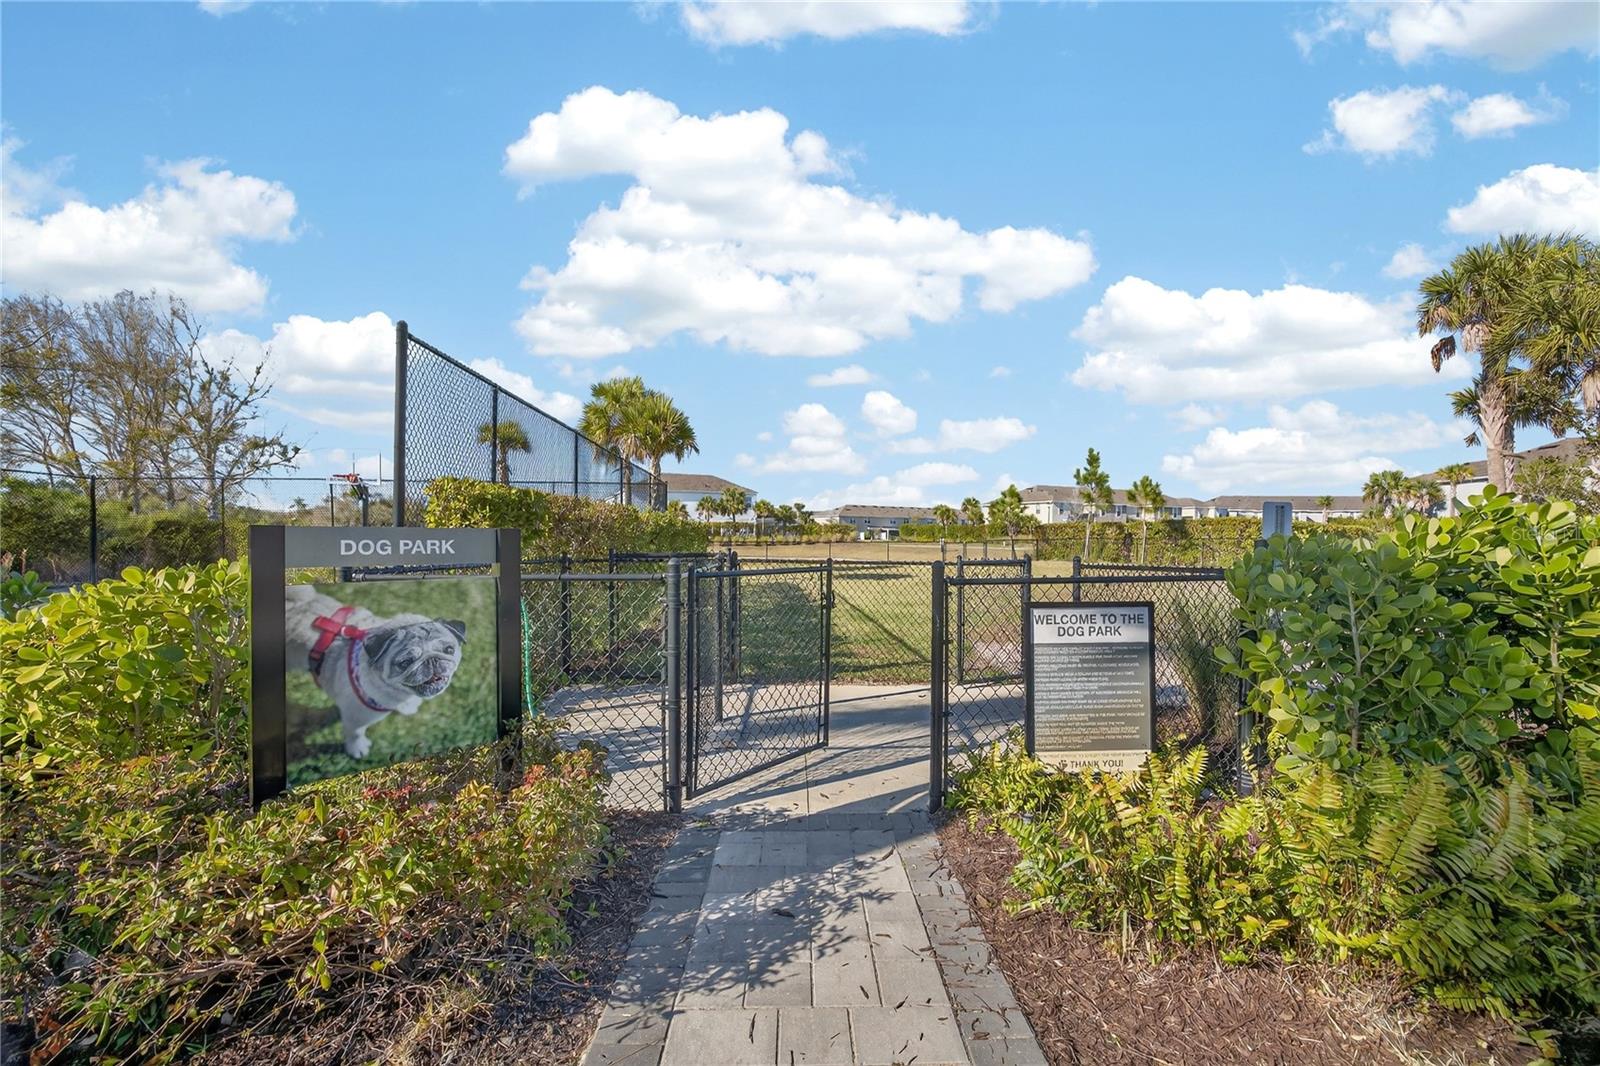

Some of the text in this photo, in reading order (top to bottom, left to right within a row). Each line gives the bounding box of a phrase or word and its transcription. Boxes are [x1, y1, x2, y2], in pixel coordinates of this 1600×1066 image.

[340, 540, 456, 555] DOG PARK
[1034, 613, 1144, 625] WELCOME TO THE
[1057, 626, 1122, 637] DOG PARK
[1070, 759, 1124, 769] THANK YOU!
